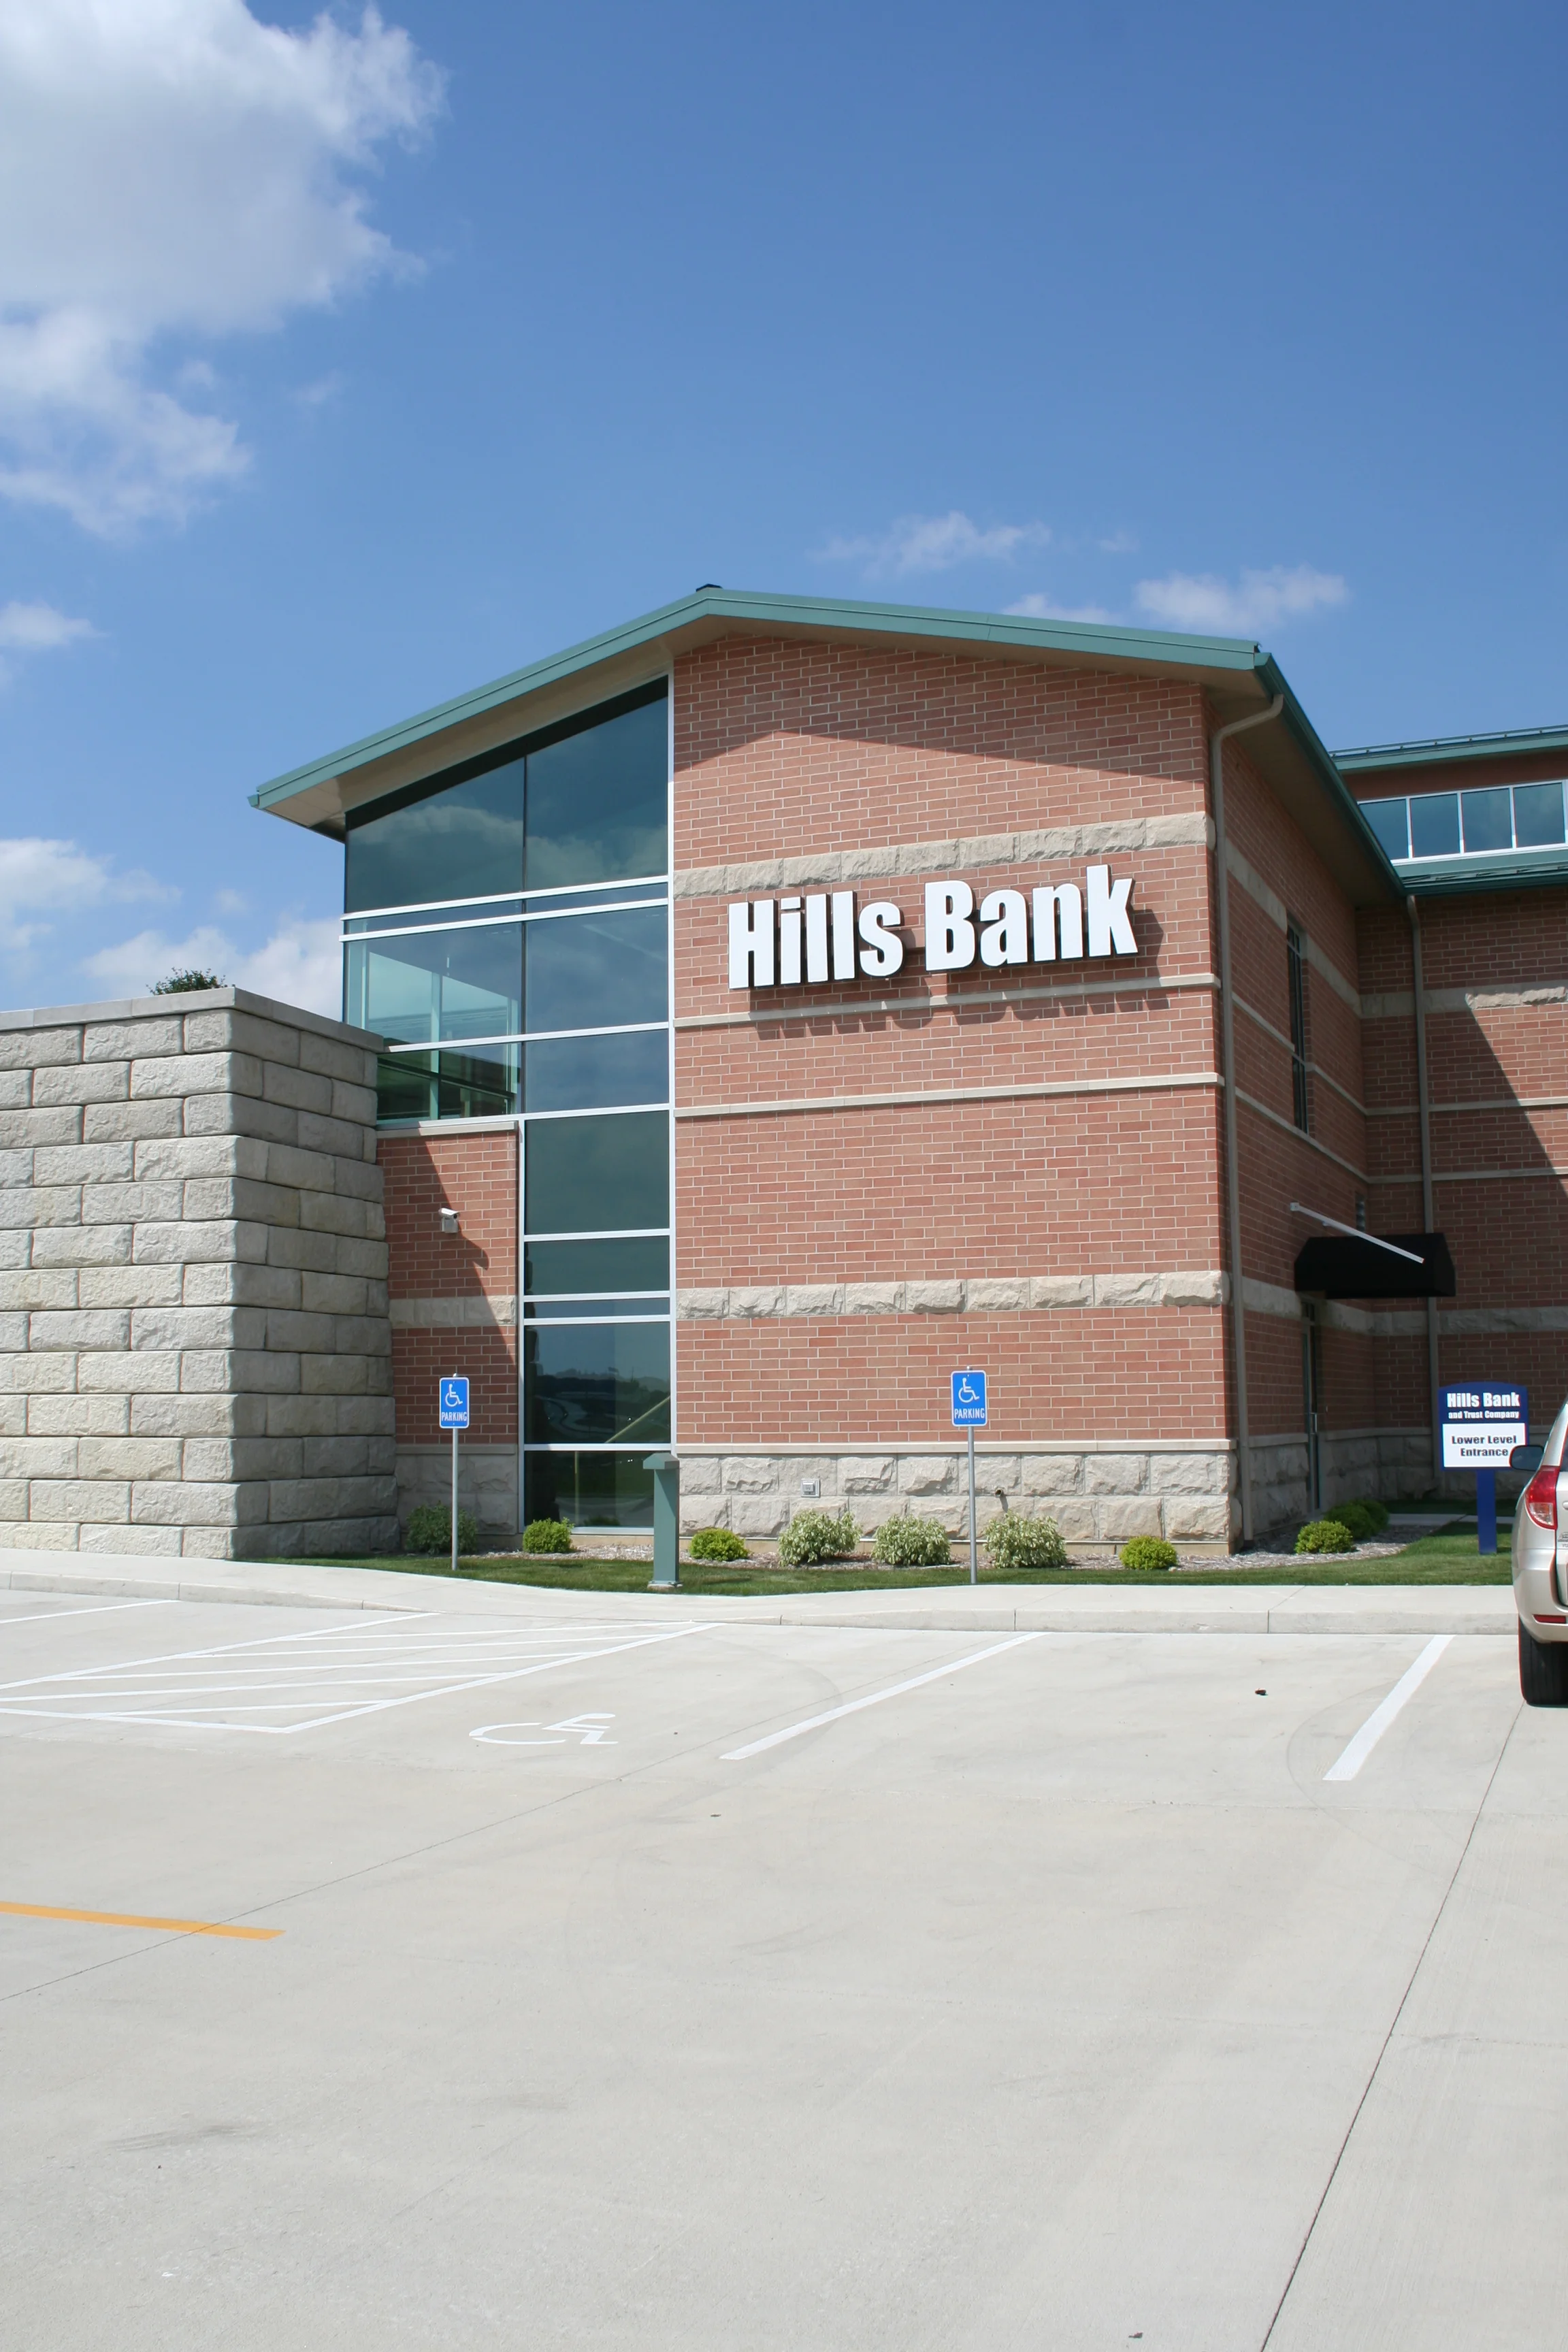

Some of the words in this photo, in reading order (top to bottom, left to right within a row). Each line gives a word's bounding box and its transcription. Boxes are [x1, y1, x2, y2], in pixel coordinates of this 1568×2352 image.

[728, 889, 904, 989] Hills
[924, 864, 1139, 973] Bank
[1447, 1392, 1480, 1407] Hills
[1483, 1392, 1520, 1407] Bank
[441, 1411, 468, 1422] PARKING
[954, 1407, 985, 1419] PARKING
[1448, 1411, 1463, 1419] and
[1463, 1411, 1483, 1419] Trust
[1484, 1410, 1520, 1419] Company
[1451, 1435, 1485, 1444] Lower
[1487, 1435, 1517, 1444] Level
[1460, 1448, 1509, 1456] Entrance
